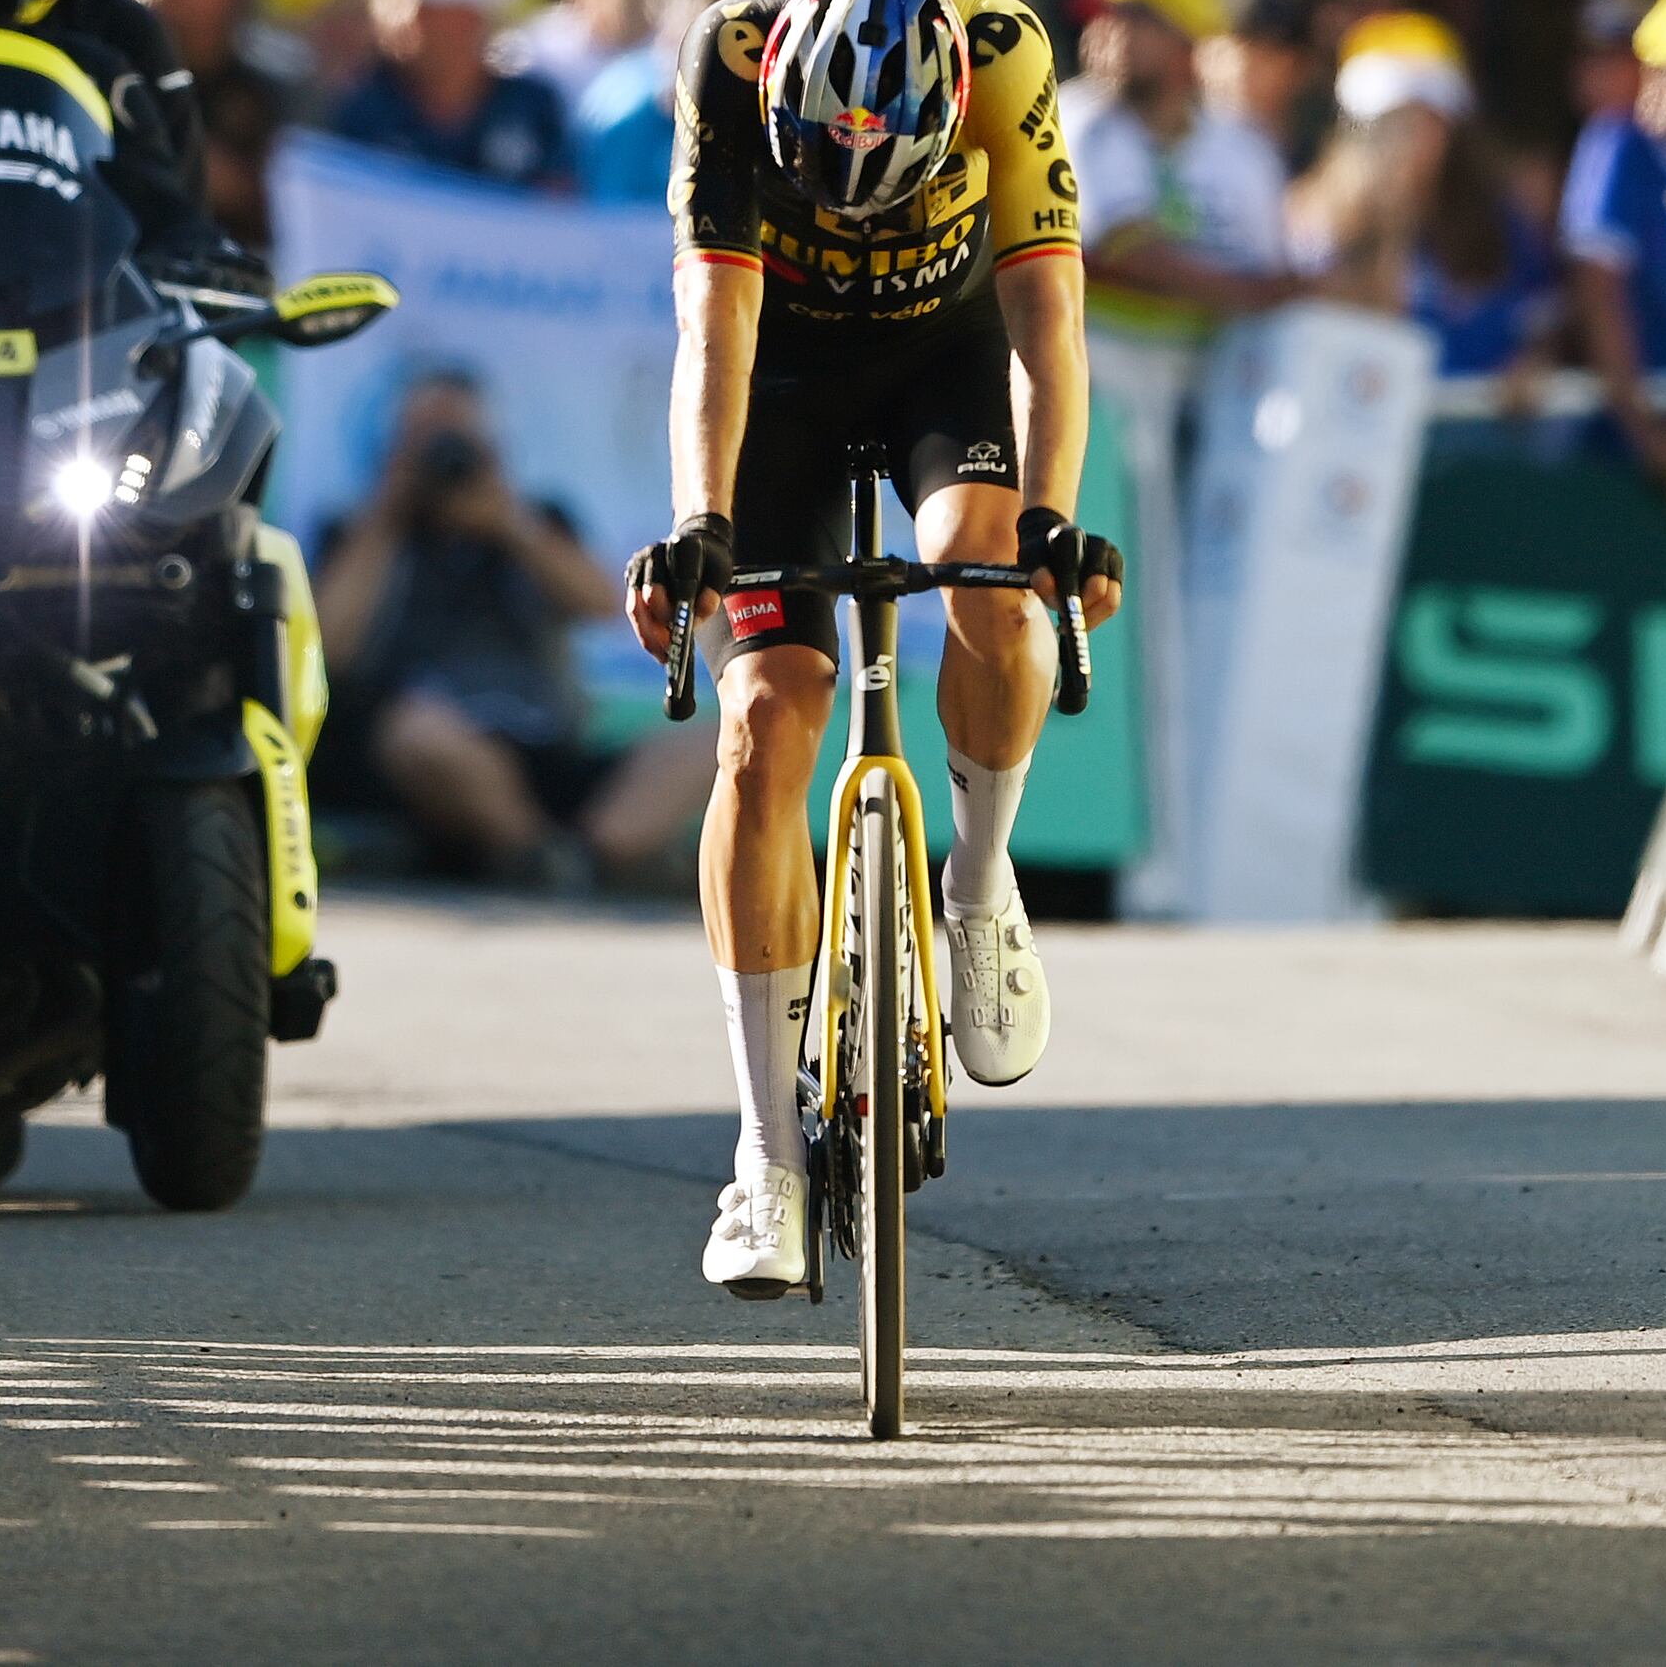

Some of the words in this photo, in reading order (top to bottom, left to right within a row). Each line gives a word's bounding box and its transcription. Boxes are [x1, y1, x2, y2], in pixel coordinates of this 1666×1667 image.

[826, 241, 971, 296] VISMA
[957, 460, 1007, 476] AGU
[733, 601, 778, 624] HEMA
